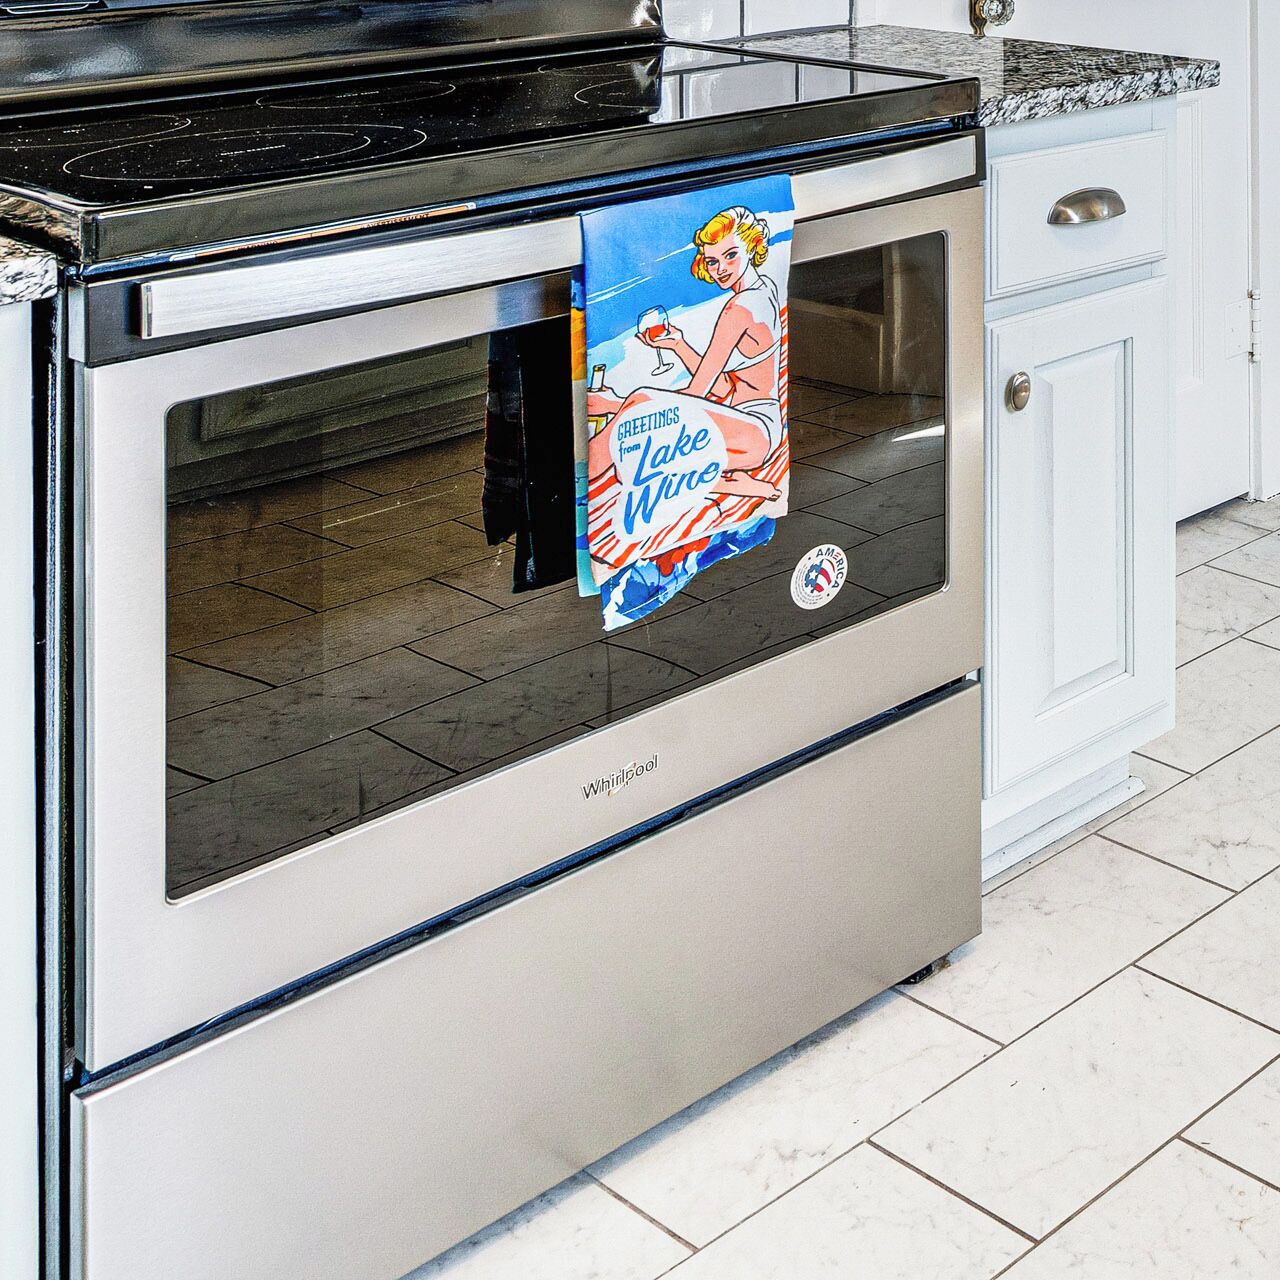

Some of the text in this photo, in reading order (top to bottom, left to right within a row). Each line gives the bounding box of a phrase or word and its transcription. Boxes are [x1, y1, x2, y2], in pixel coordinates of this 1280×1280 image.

[617, 406, 680, 441] GREETINGS
[619, 423, 712, 487] from Lake
[623, 461, 720, 535] Wine
[816, 547, 845, 589] AMERICA
[582, 753, 659, 800] Whirlpool
